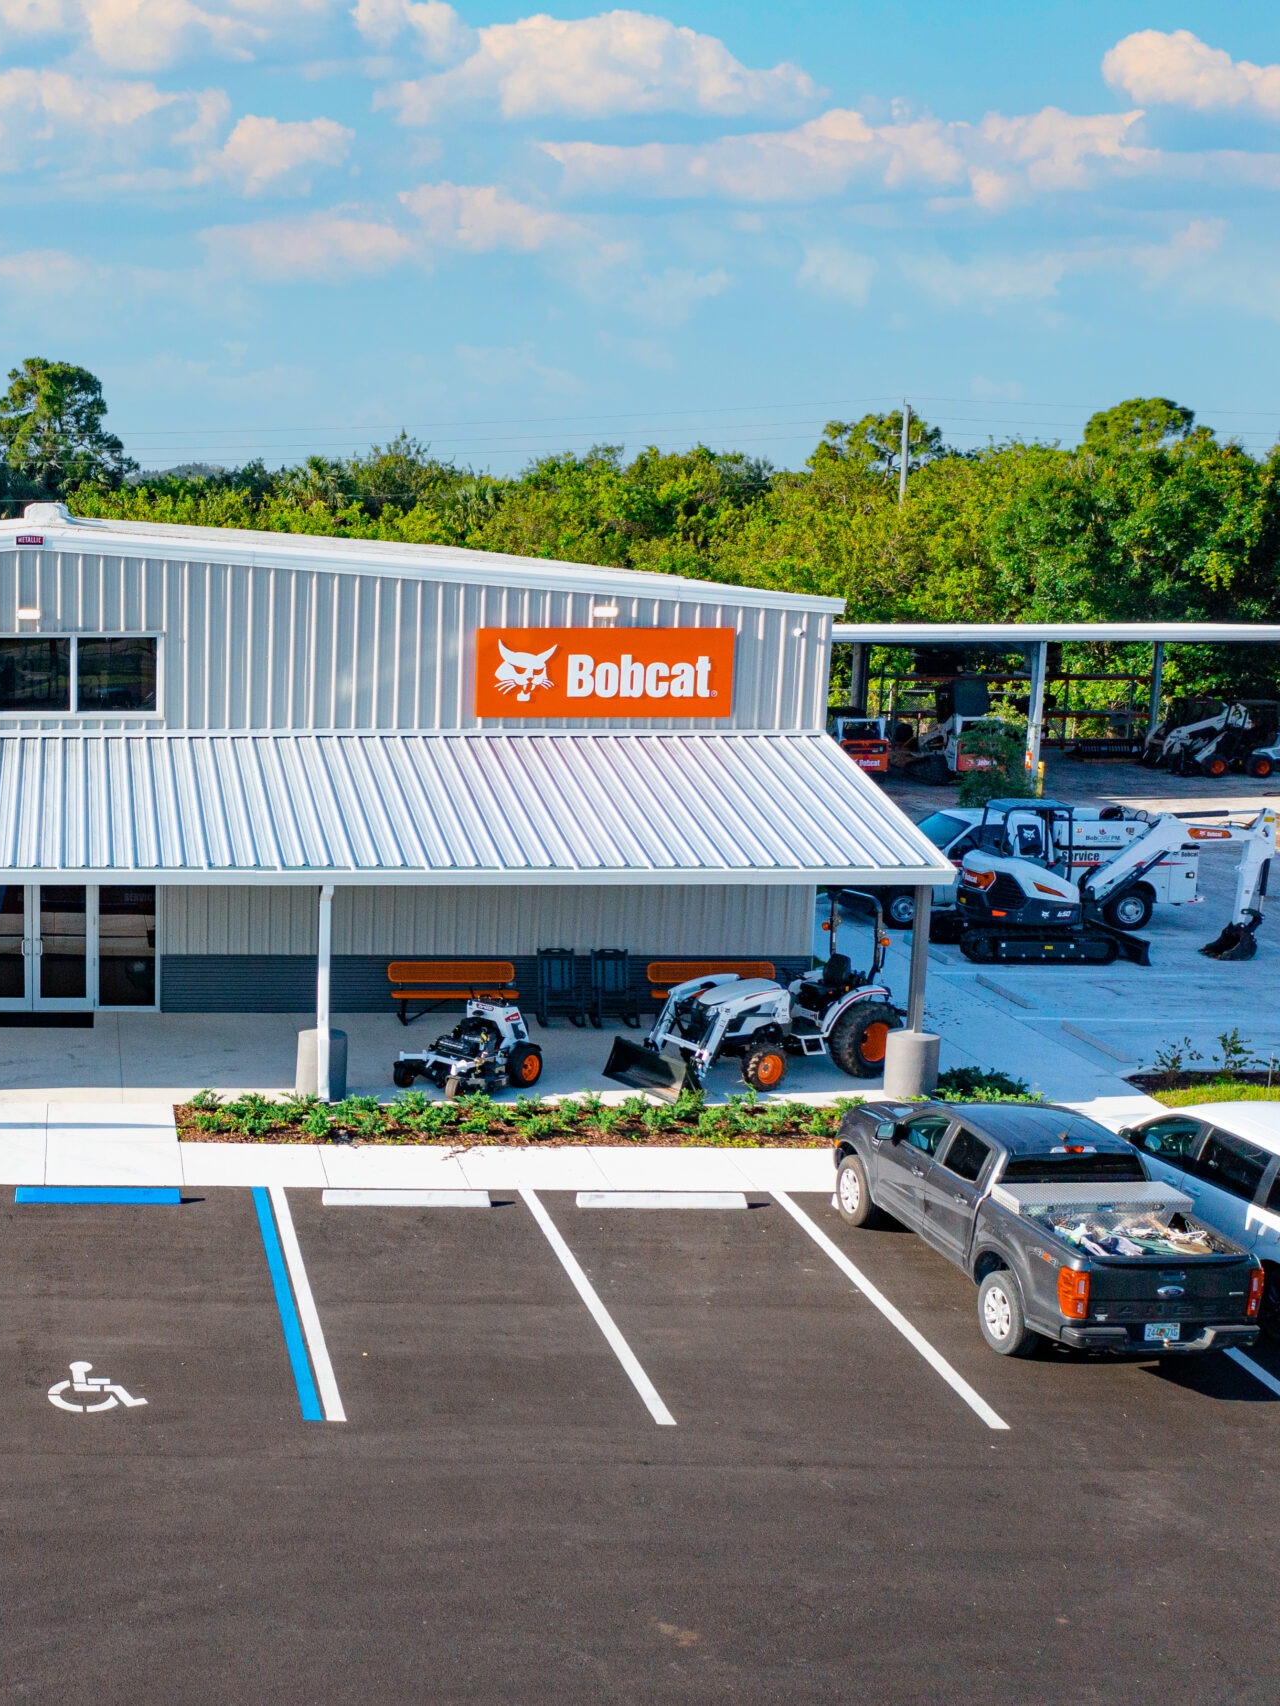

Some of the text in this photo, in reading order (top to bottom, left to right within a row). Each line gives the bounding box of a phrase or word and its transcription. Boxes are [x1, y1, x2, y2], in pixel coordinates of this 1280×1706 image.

[18, 536, 42, 544] METALLIC
[566, 654, 712, 697] Bobcat
[1061, 850, 1100, 861] Srvice
